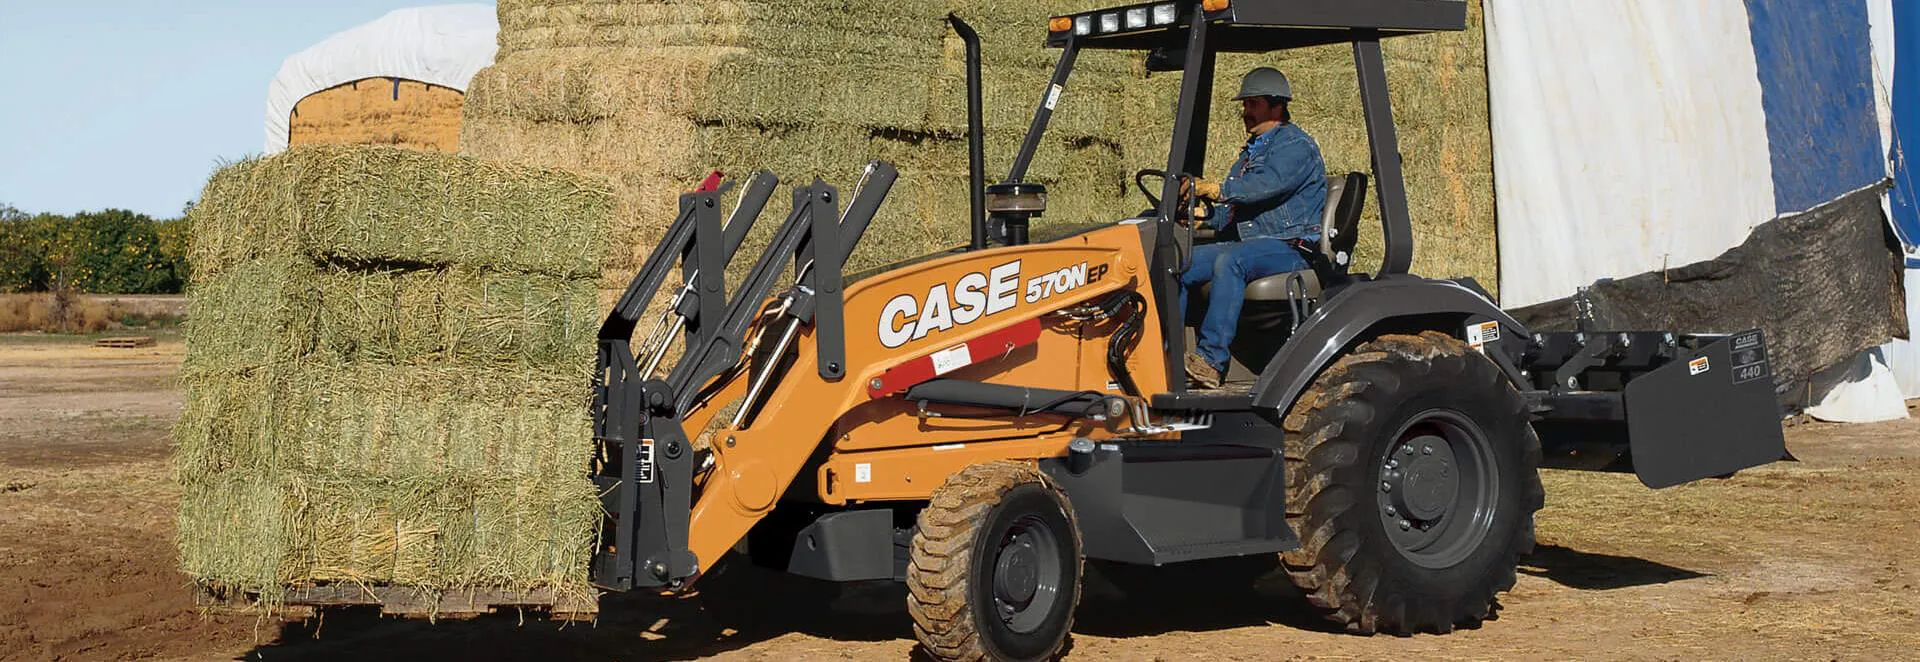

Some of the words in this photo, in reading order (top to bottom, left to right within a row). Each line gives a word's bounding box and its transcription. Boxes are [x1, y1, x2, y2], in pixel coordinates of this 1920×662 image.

[878, 259, 1022, 348] CASE
[1025, 261, 1088, 303] 570N
[1736, 334, 1758, 345] CASE
[1740, 365, 1761, 380] 440
